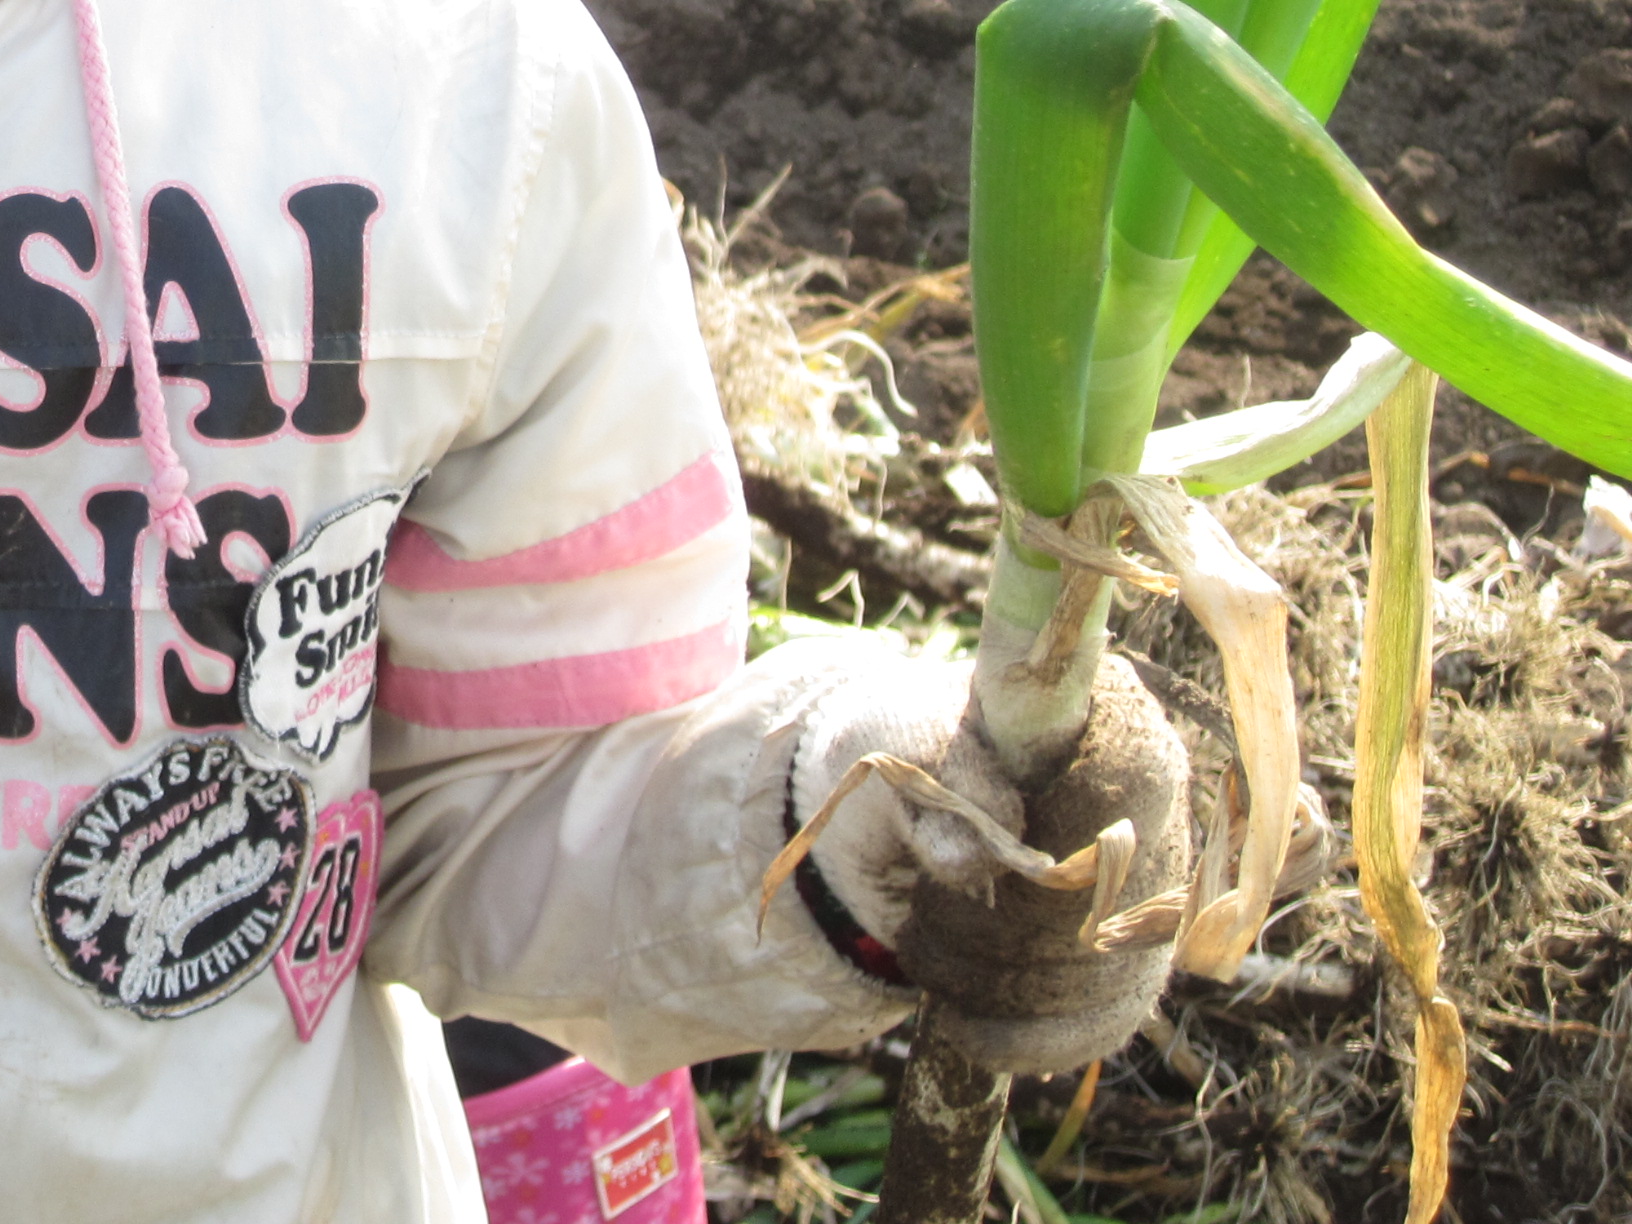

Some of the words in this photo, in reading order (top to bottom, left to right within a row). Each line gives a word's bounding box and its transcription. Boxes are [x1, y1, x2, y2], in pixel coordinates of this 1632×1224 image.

[53, 750, 191, 904] ALWAYS
[142, 907, 281, 999] ONDERFUL
[293, 832, 361, 964] 28
